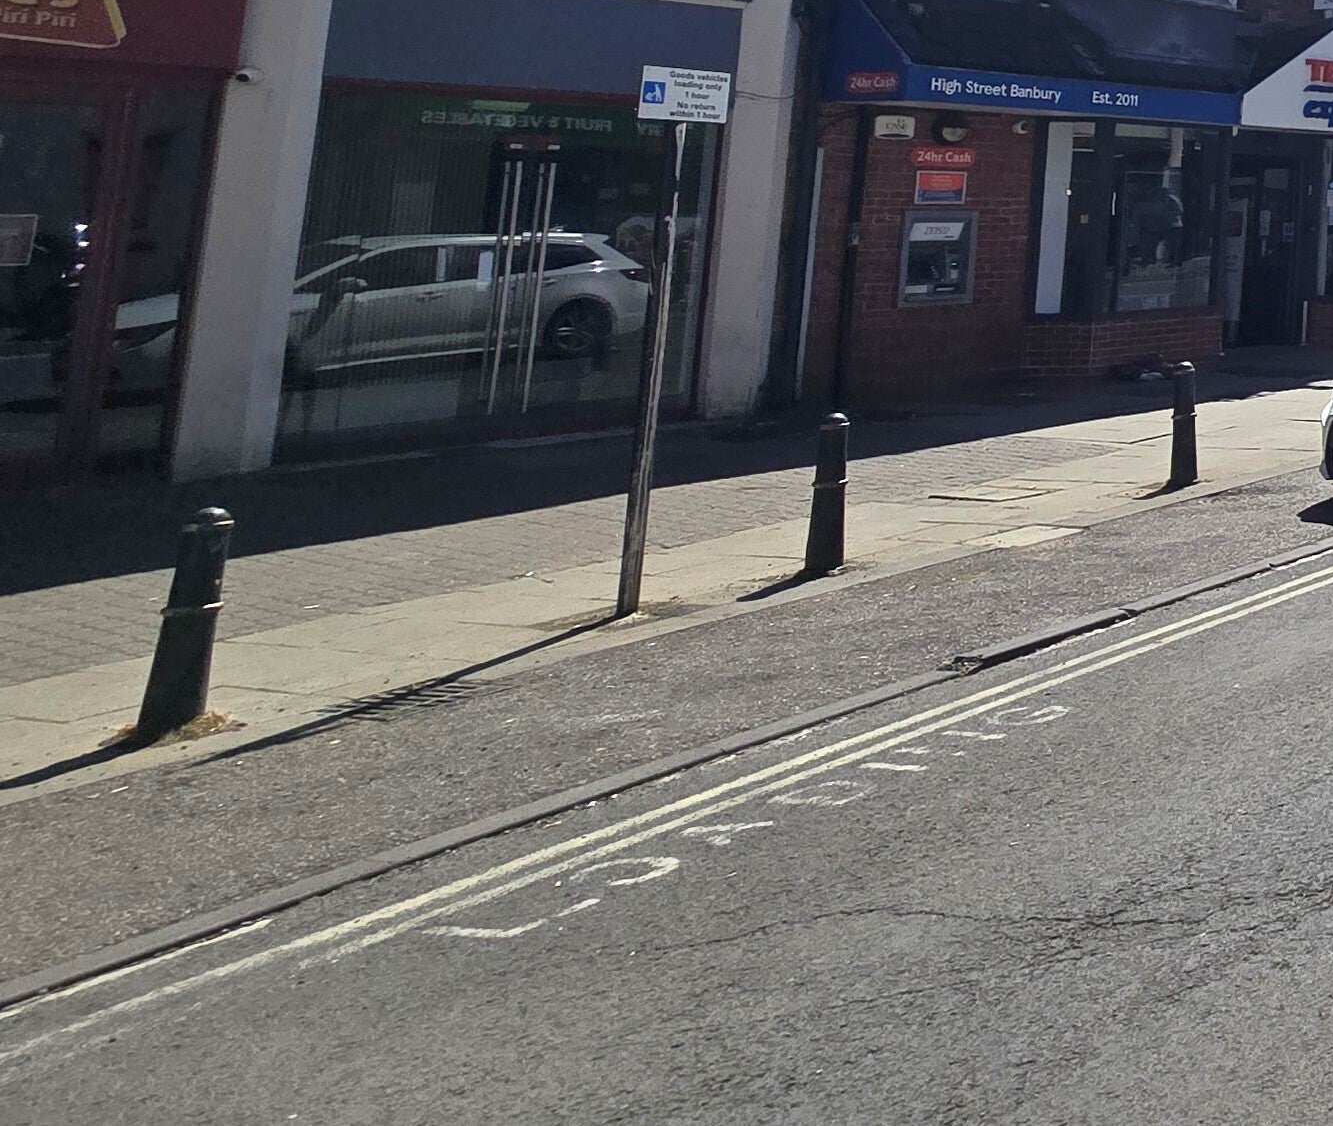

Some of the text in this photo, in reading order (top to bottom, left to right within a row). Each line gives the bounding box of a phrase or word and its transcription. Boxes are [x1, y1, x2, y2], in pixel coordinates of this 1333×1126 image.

[0, 7, 77, 28] iri Piri
[669, 70, 728, 82] Goods vehicles
[850, 75, 896, 89] 24hr Cash
[674, 79, 722, 91] loading only
[931, 77, 1061, 103] High Street Banbury
[691, 91, 710, 100] hour
[1092, 90, 1139, 107] Est. 2011
[677, 101, 716, 111] No return
[669, 110, 695, 118] within
[702, 112, 721, 120] hour
[917, 150, 971, 163] 24hr Cash
